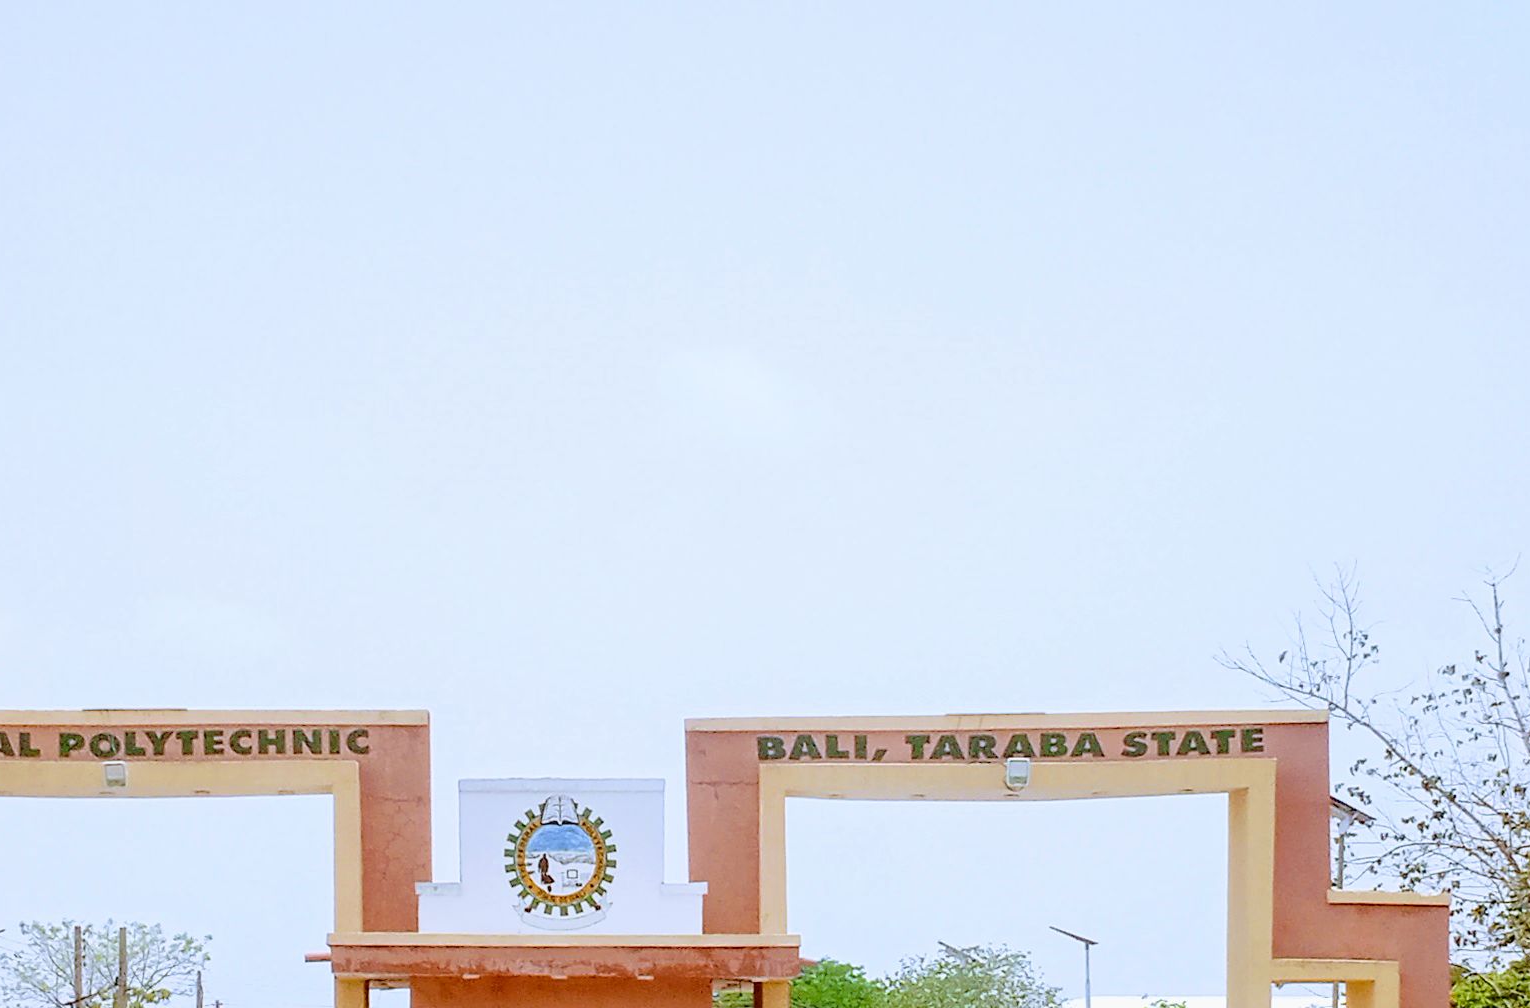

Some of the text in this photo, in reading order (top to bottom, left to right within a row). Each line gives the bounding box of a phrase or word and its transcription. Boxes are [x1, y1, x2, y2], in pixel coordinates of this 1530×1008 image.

[58, 728, 370, 759] POLYTECHNIC
[756, 728, 1265, 762] BALI, TARABA STATE
